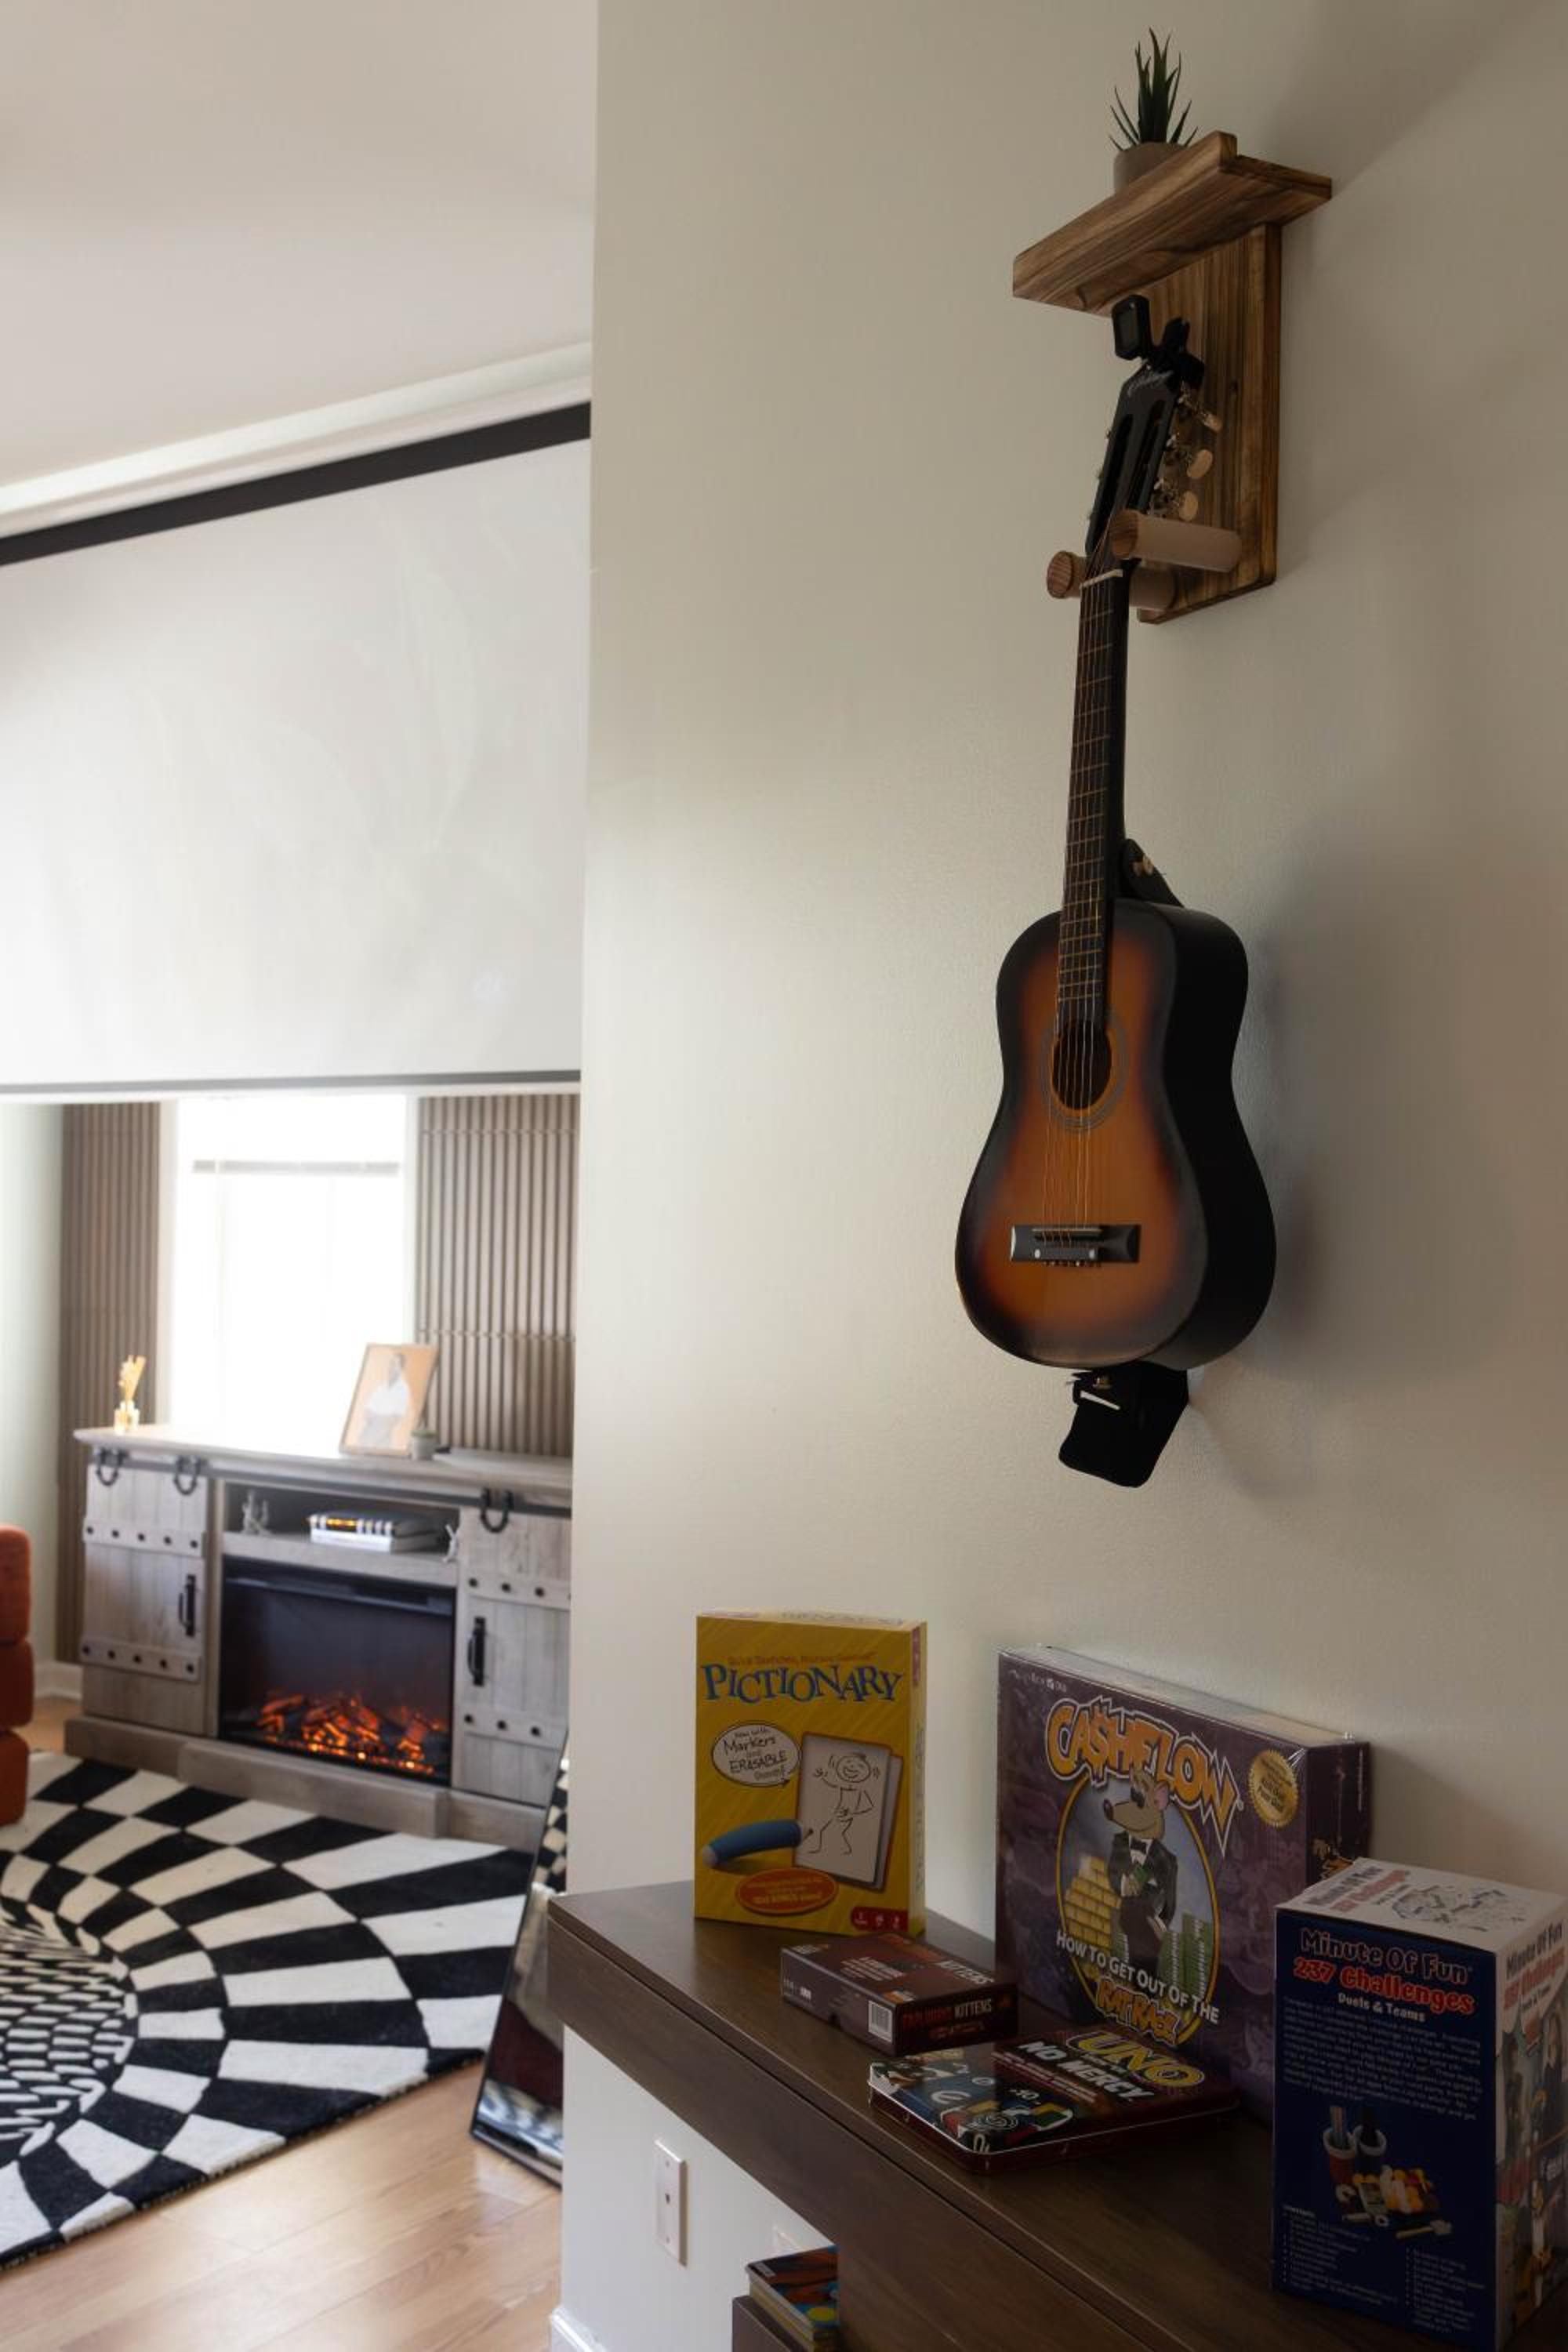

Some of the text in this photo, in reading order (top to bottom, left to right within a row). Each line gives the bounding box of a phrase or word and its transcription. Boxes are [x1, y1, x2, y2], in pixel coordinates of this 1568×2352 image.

[701, 1663, 902, 1703] PICTIONARY
[723, 1736, 776, 1755] Markers
[729, 1750, 788, 1773] ERASABLE
[1056, 1931, 1221, 2024] HOW TO GET OUT OF THE
[1299, 1927, 1383, 1967] Minute
[1421, 1952, 1468, 1985] Fun
[953, 1997, 993, 2020] KITTENS
[1294, 1956, 1337, 1985] 237
[1338, 1965, 1476, 2016] Challenges
[1338, 1992, 1426, 2023] Duels & Teams
[1019, 2040, 1067, 2063] NO
[1056, 2060, 1156, 2103] MERCY
[1066, 2031, 1206, 2090] UNO
